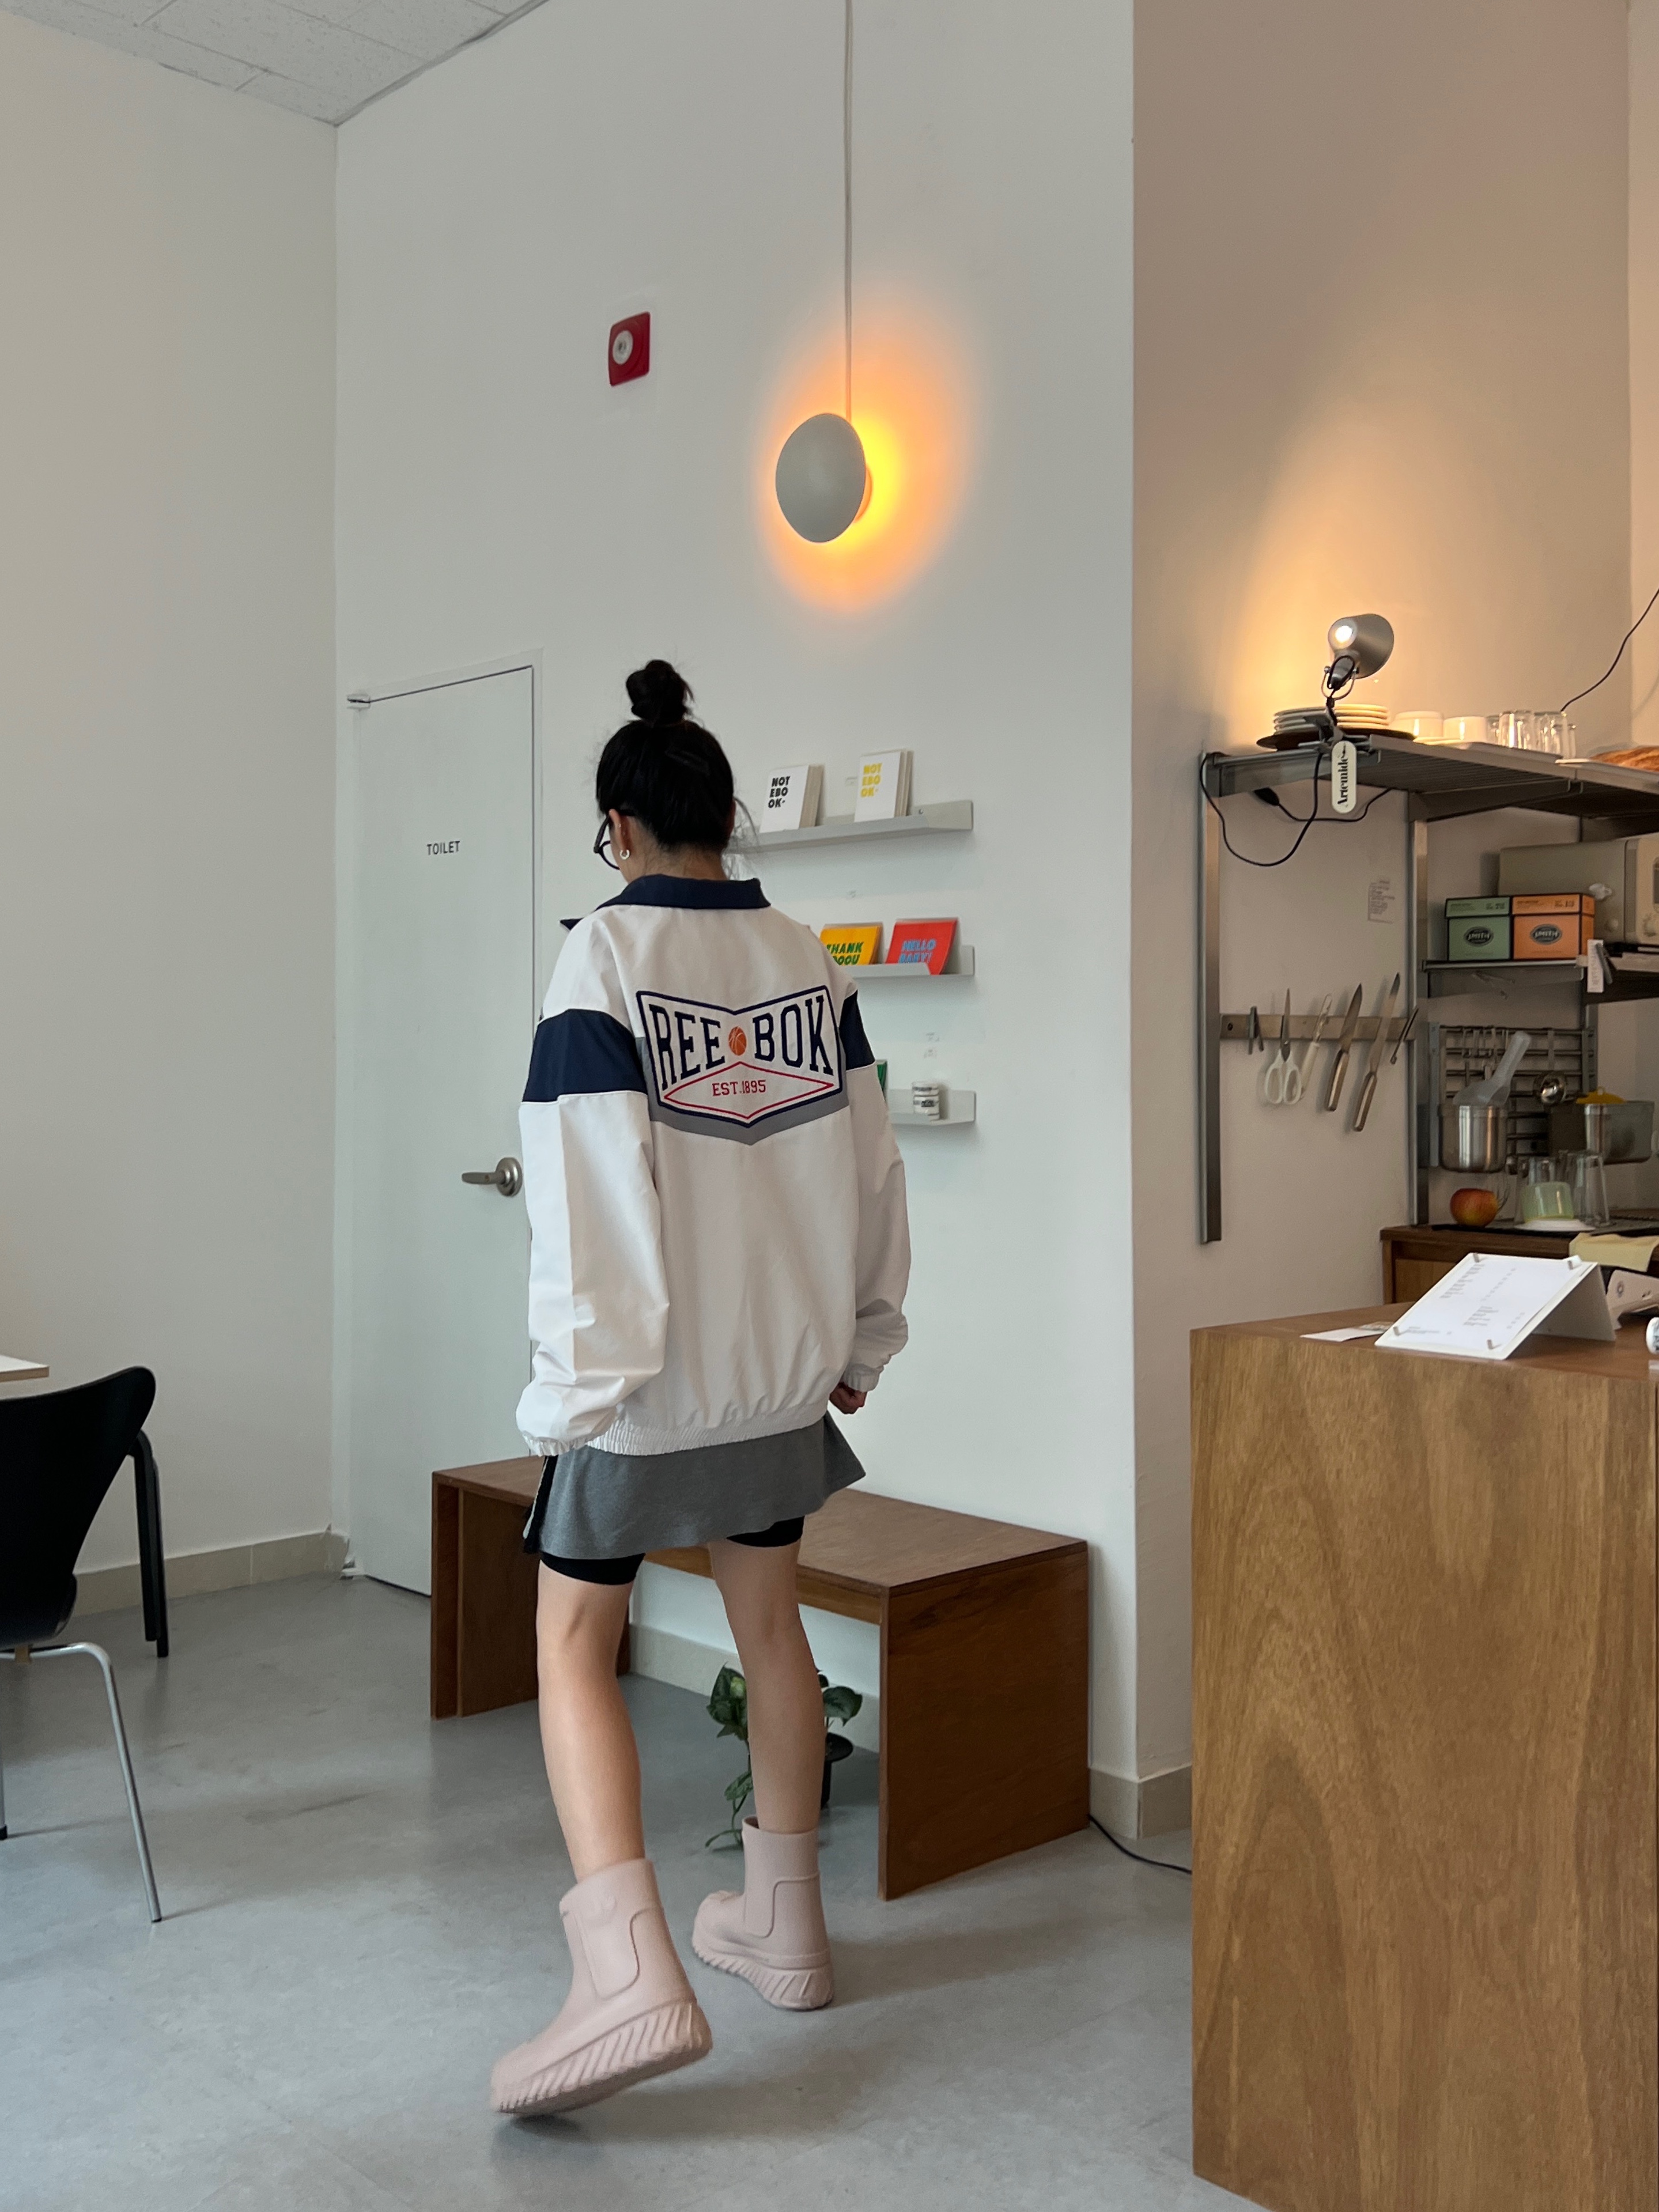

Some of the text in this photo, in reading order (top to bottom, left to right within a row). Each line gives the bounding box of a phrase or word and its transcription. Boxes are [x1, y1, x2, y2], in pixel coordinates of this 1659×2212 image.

[863, 763, 882, 774] NOT
[772, 776, 790, 787] NOT
[861, 774, 880, 786] EBO
[769, 787, 788, 797] EBO
[426, 841, 460, 856] TOILET
[648, 995, 834, 1091] REE BOK
